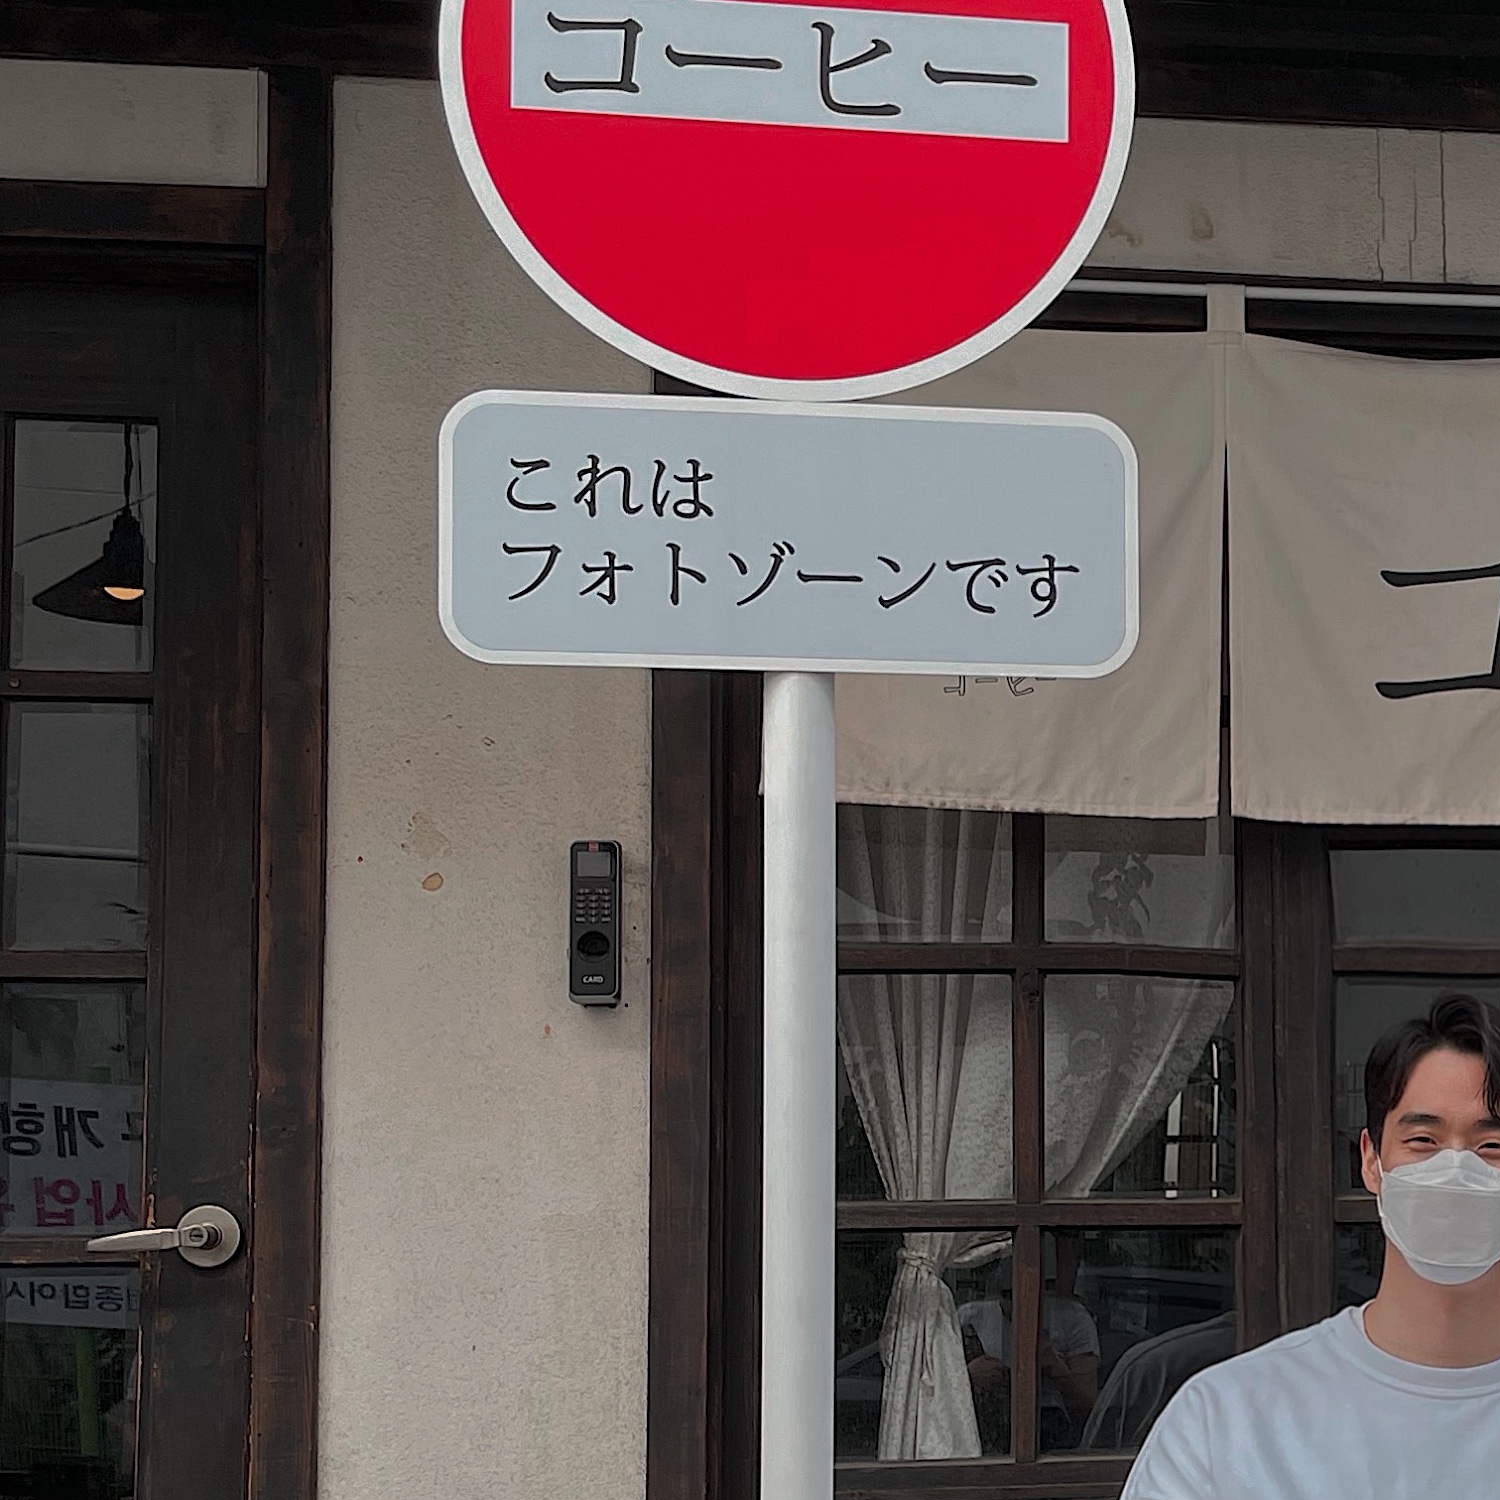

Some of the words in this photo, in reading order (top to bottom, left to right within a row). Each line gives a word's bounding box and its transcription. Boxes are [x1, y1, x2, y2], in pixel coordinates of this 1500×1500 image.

[544, 10, 1039, 117] コーヒー
[504, 453, 715, 520] これは
[501, 540, 1080, 618] フォトゾーンです
[582, 976, 604, 984] CARD
